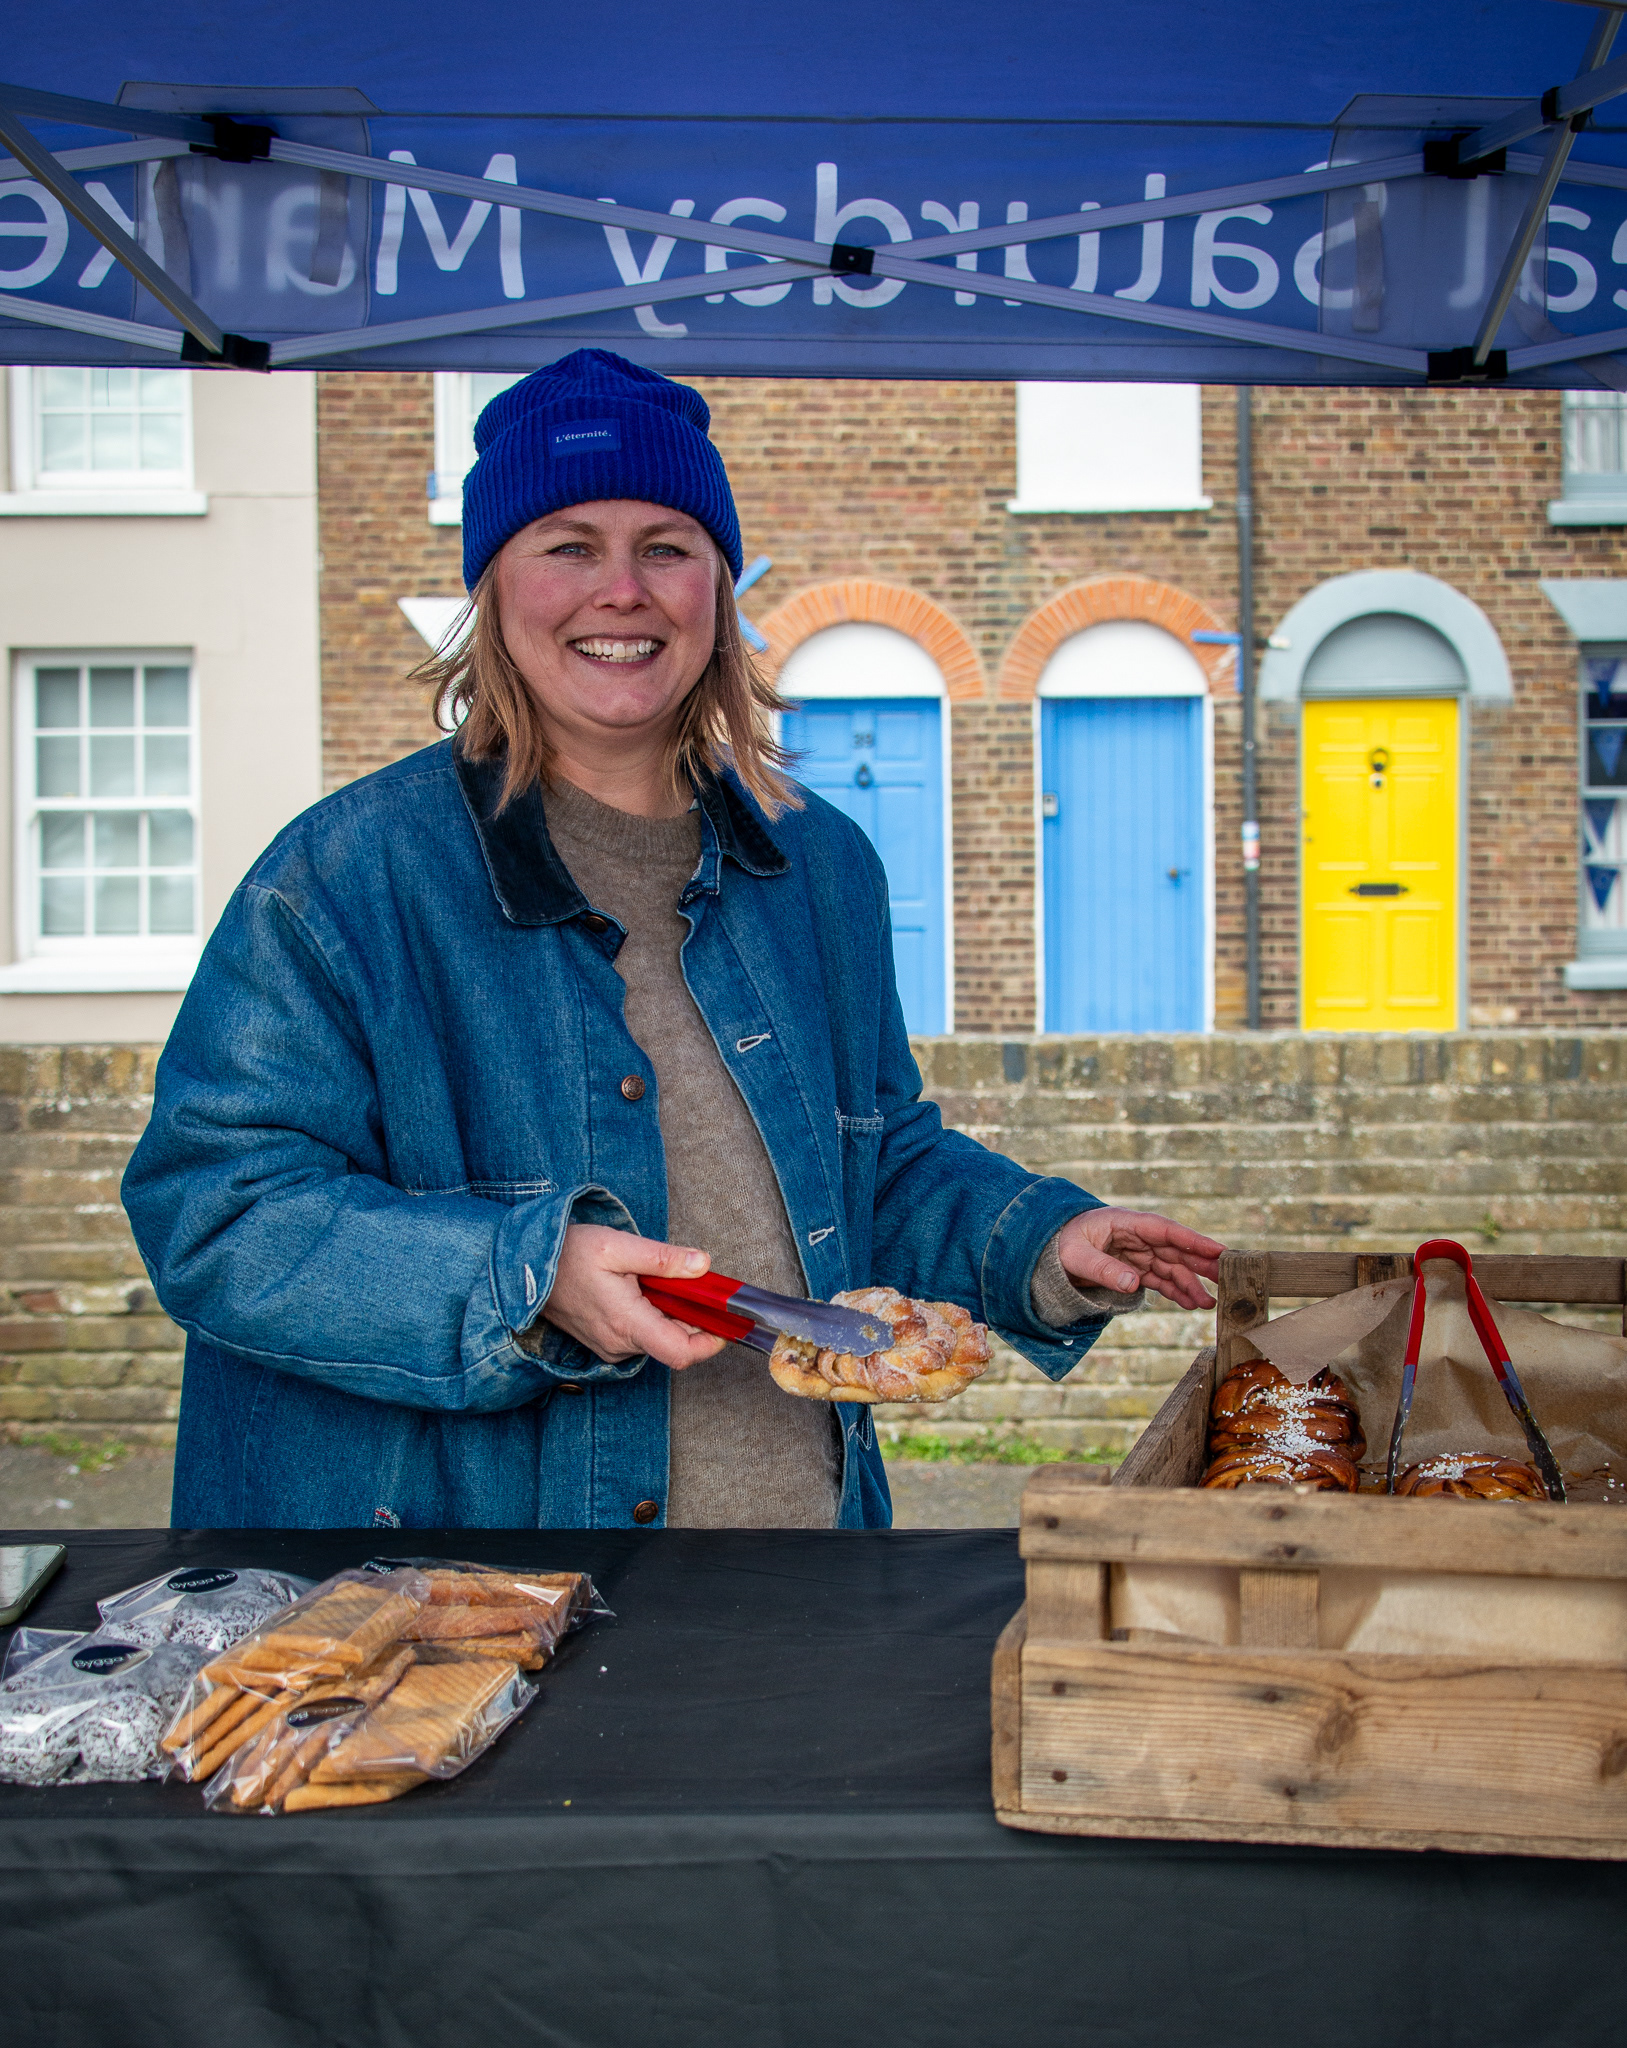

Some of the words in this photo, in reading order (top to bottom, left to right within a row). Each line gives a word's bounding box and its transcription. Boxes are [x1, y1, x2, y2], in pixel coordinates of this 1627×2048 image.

[169, 1577, 215, 1589] Bygga
[215, 1572, 236, 1581] Bo
[74, 1656, 124, 1669] Bygga
